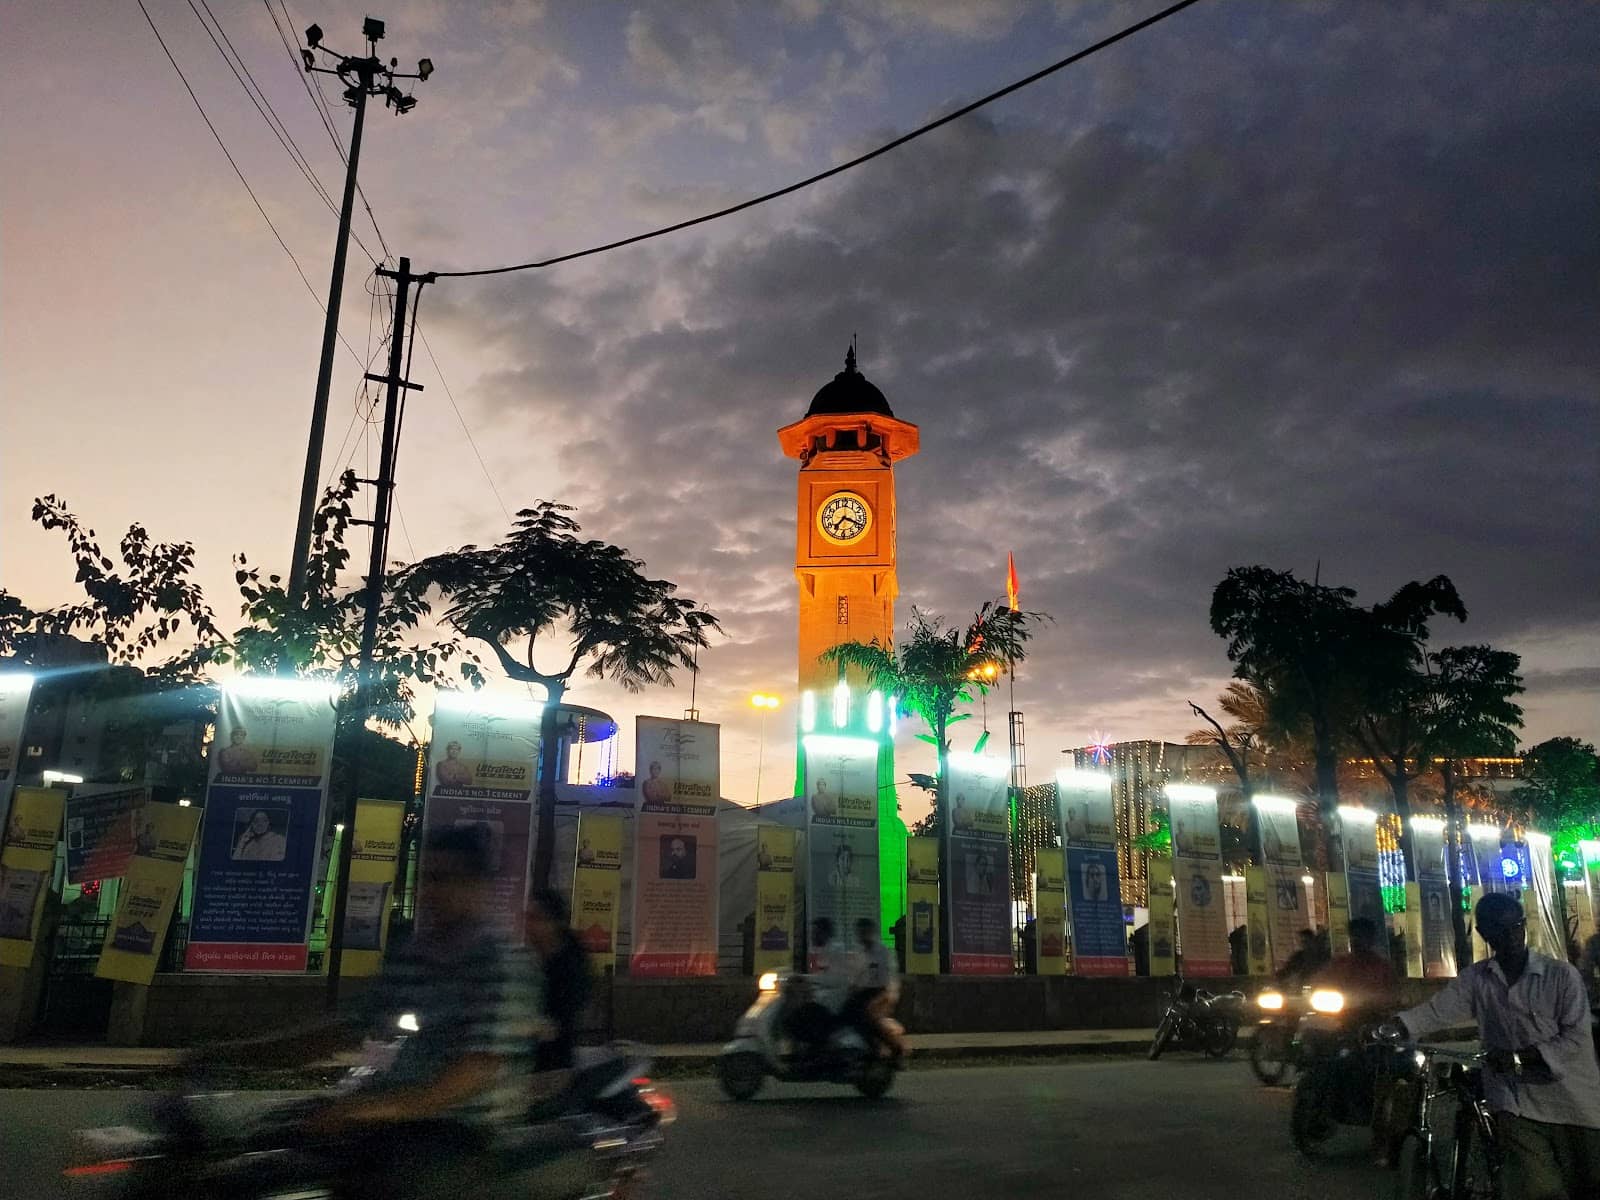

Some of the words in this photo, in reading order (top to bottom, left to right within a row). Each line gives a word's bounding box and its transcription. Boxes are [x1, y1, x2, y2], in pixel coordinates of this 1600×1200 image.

[263, 749, 317, 760] UltraTech
[476, 763, 526, 775] UltraTech
[222, 775, 253, 784] INDIA'S
[256, 775, 277, 785] NO.1
[278, 776, 313, 785] CEMENT
[673, 782, 712, 792] UltraTech
[440, 787, 471, 796] INDIA'S
[472, 788, 491, 797] NO.1
[492, 790, 524, 799] CEMENT
[838, 796, 872, 805] UltraTech
